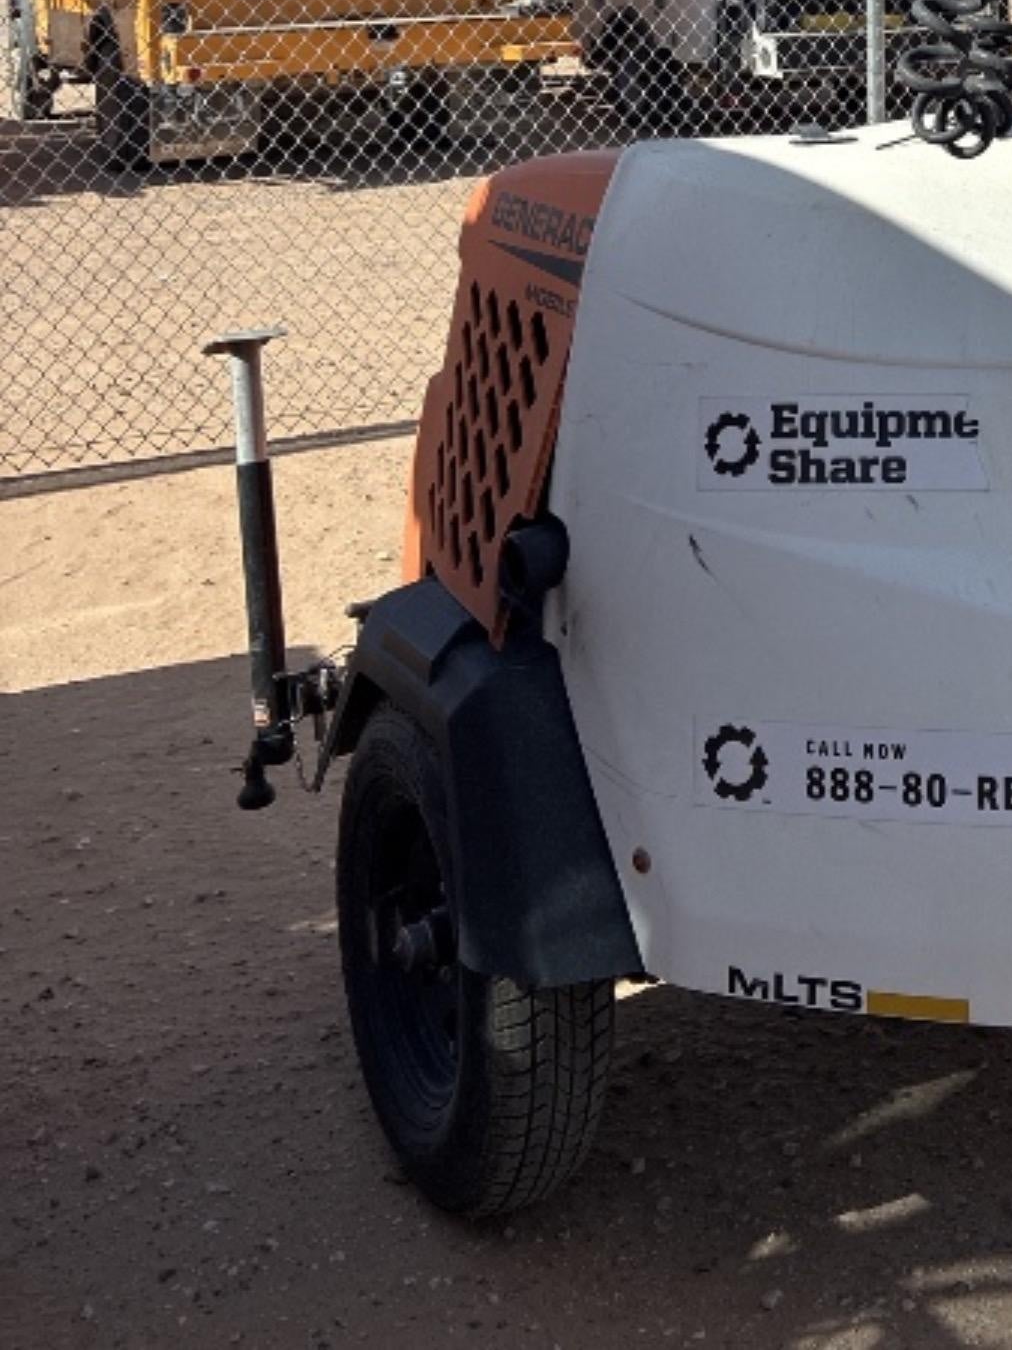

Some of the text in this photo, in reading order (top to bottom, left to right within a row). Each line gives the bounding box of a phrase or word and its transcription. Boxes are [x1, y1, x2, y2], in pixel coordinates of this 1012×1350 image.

[491, 191, 596, 256] GENERAC
[768, 449, 907, 484] Share
[806, 739, 907, 760] CALL NOW
[728, 965, 863, 1010] MLTS
